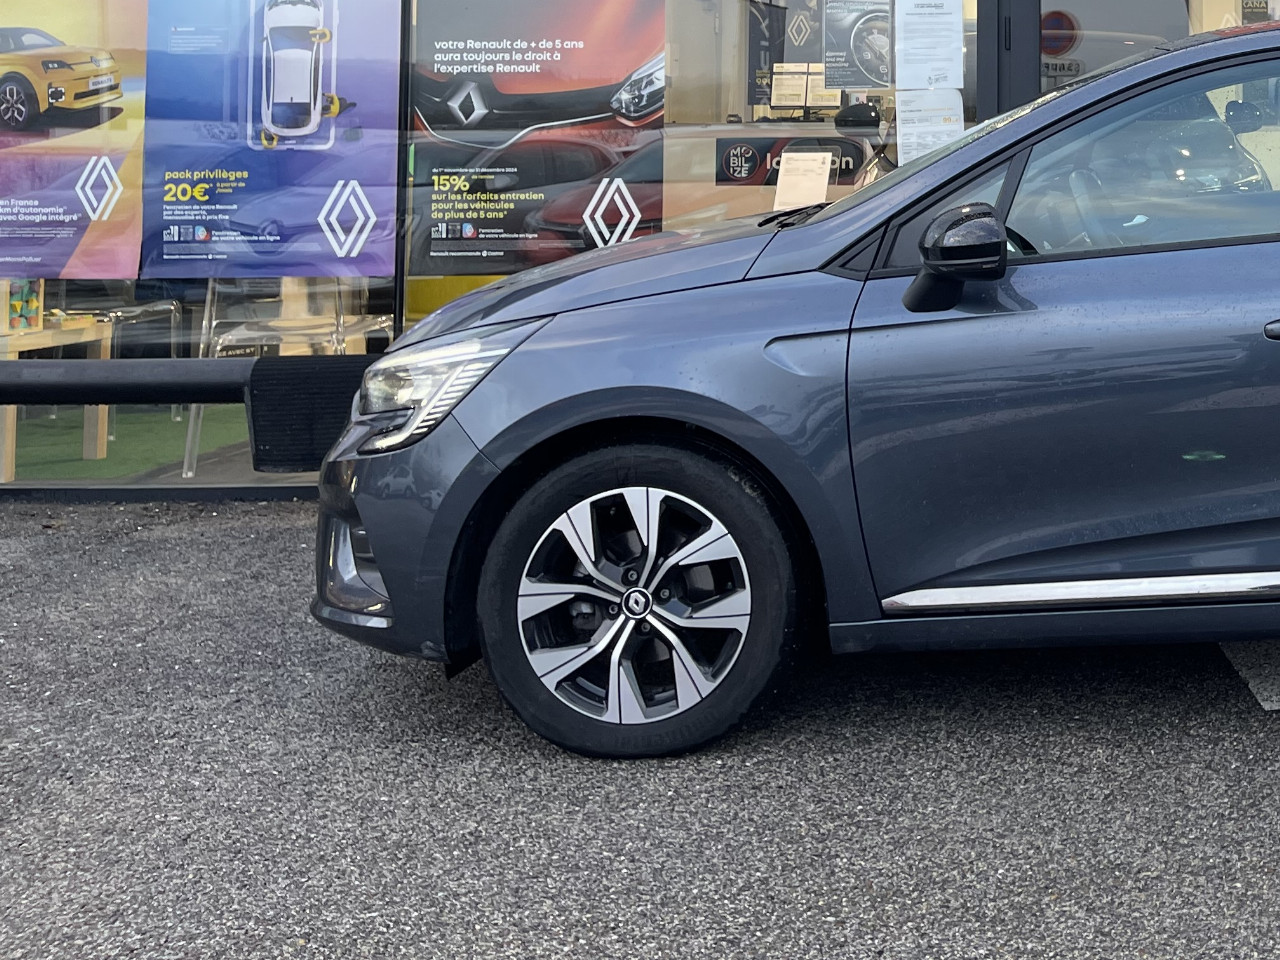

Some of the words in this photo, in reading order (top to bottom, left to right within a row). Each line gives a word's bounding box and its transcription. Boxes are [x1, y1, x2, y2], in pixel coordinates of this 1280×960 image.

[434, 40, 465, 49] votre
[466, 39, 511, 49] Renault
[513, 39, 528, 49] de
[538, 39, 553, 49] de
[555, 39, 561, 49] 5
[563, 41, 584, 49] ans
[434, 52, 461, 61] aura
[462, 51, 510, 63] toujours
[512, 51, 522, 60] le
[524, 51, 551, 61] droit
[553, 51, 561, 61] à
[434, 63, 495, 75] l'expertise
[496, 63, 541, 73] Renault
[165, 169, 192, 181] pack
[193, 169, 249, 181] privilèges
[431, 175, 470, 191] 15%
[448, 192, 462, 200] les
[463, 192, 499, 200] forfaits
[500, 192, 545, 200] entretien
[10, 198, 39, 206] France
[431, 201, 453, 211] pour
[455, 201, 469, 209] les
[469, 201, 515, 209] véhicules
[18, 213, 48, 222] Google
[431, 210, 442, 219] de
[444, 210, 465, 220] plus
[465, 210, 478, 219] de
[479, 211, 485, 219] 5
